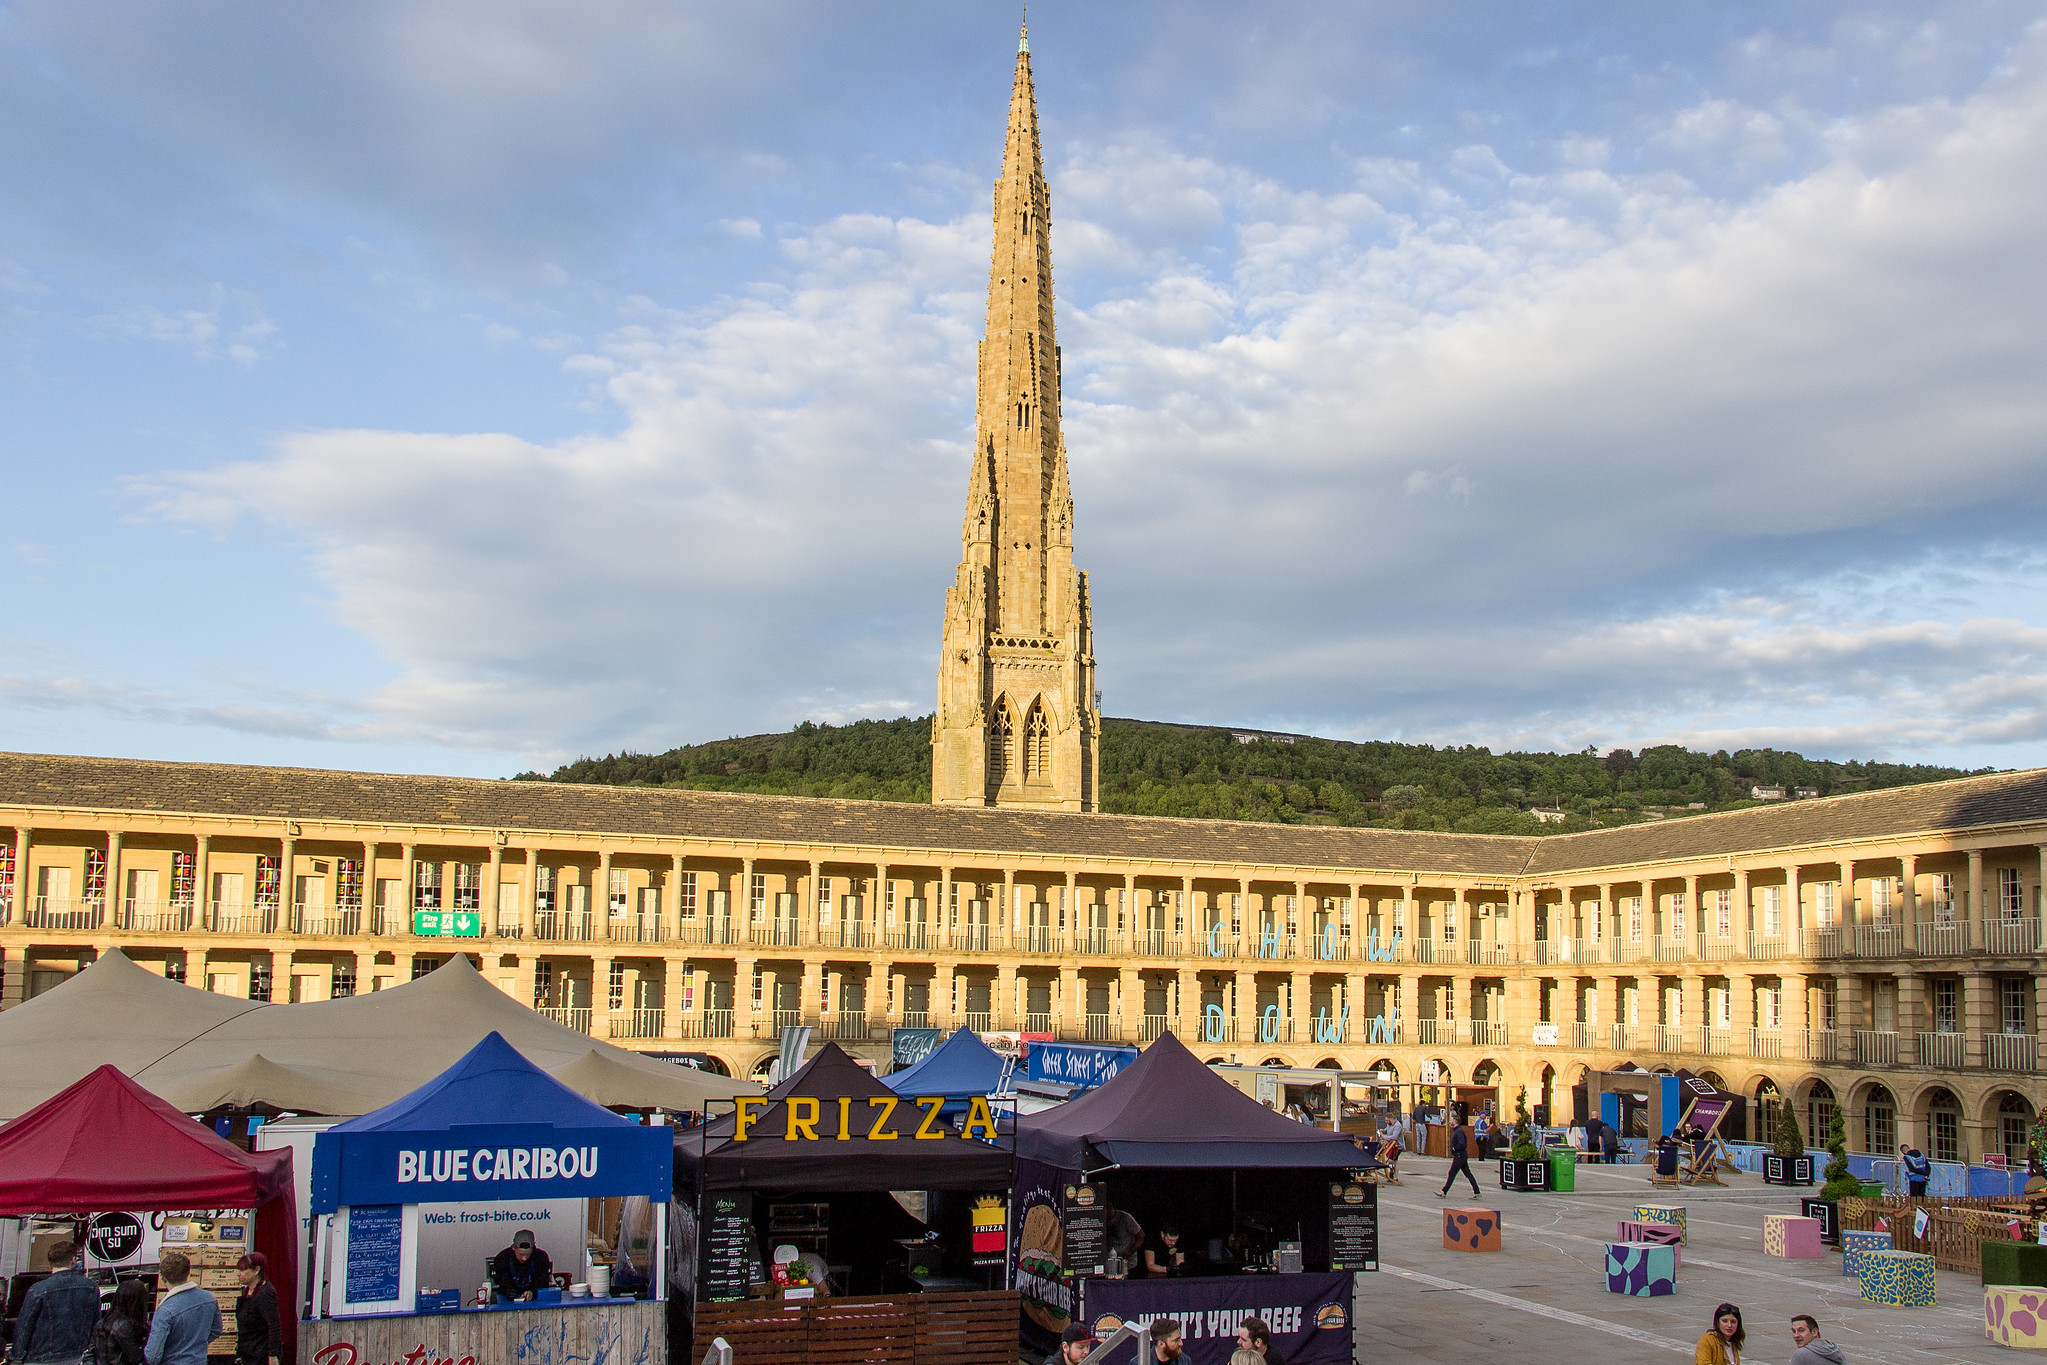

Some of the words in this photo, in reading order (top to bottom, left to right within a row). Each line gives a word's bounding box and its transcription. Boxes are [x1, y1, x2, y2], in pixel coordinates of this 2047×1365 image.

[422, 914, 438, 922] Fire
[1209, 921, 1400, 962] CHOW
[1206, 1003, 1397, 1044] DOWN
[898, 1034, 935, 1055] CHOW
[1042, 1046, 1062, 1077] GREEK
[1065, 1048, 1091, 1080] STREET
[732, 1095, 999, 1141] FRIZZA
[397, 1149, 469, 1183] BLUE
[472, 1146, 598, 1182] CARIBOU
[424, 1212, 457, 1225] Web:
[459, 1208, 551, 1224] frost-bite.co.uk
[975, 1224, 1004, 1233] FRIZZA
[1260, 1306, 1302, 1335] BEEF
